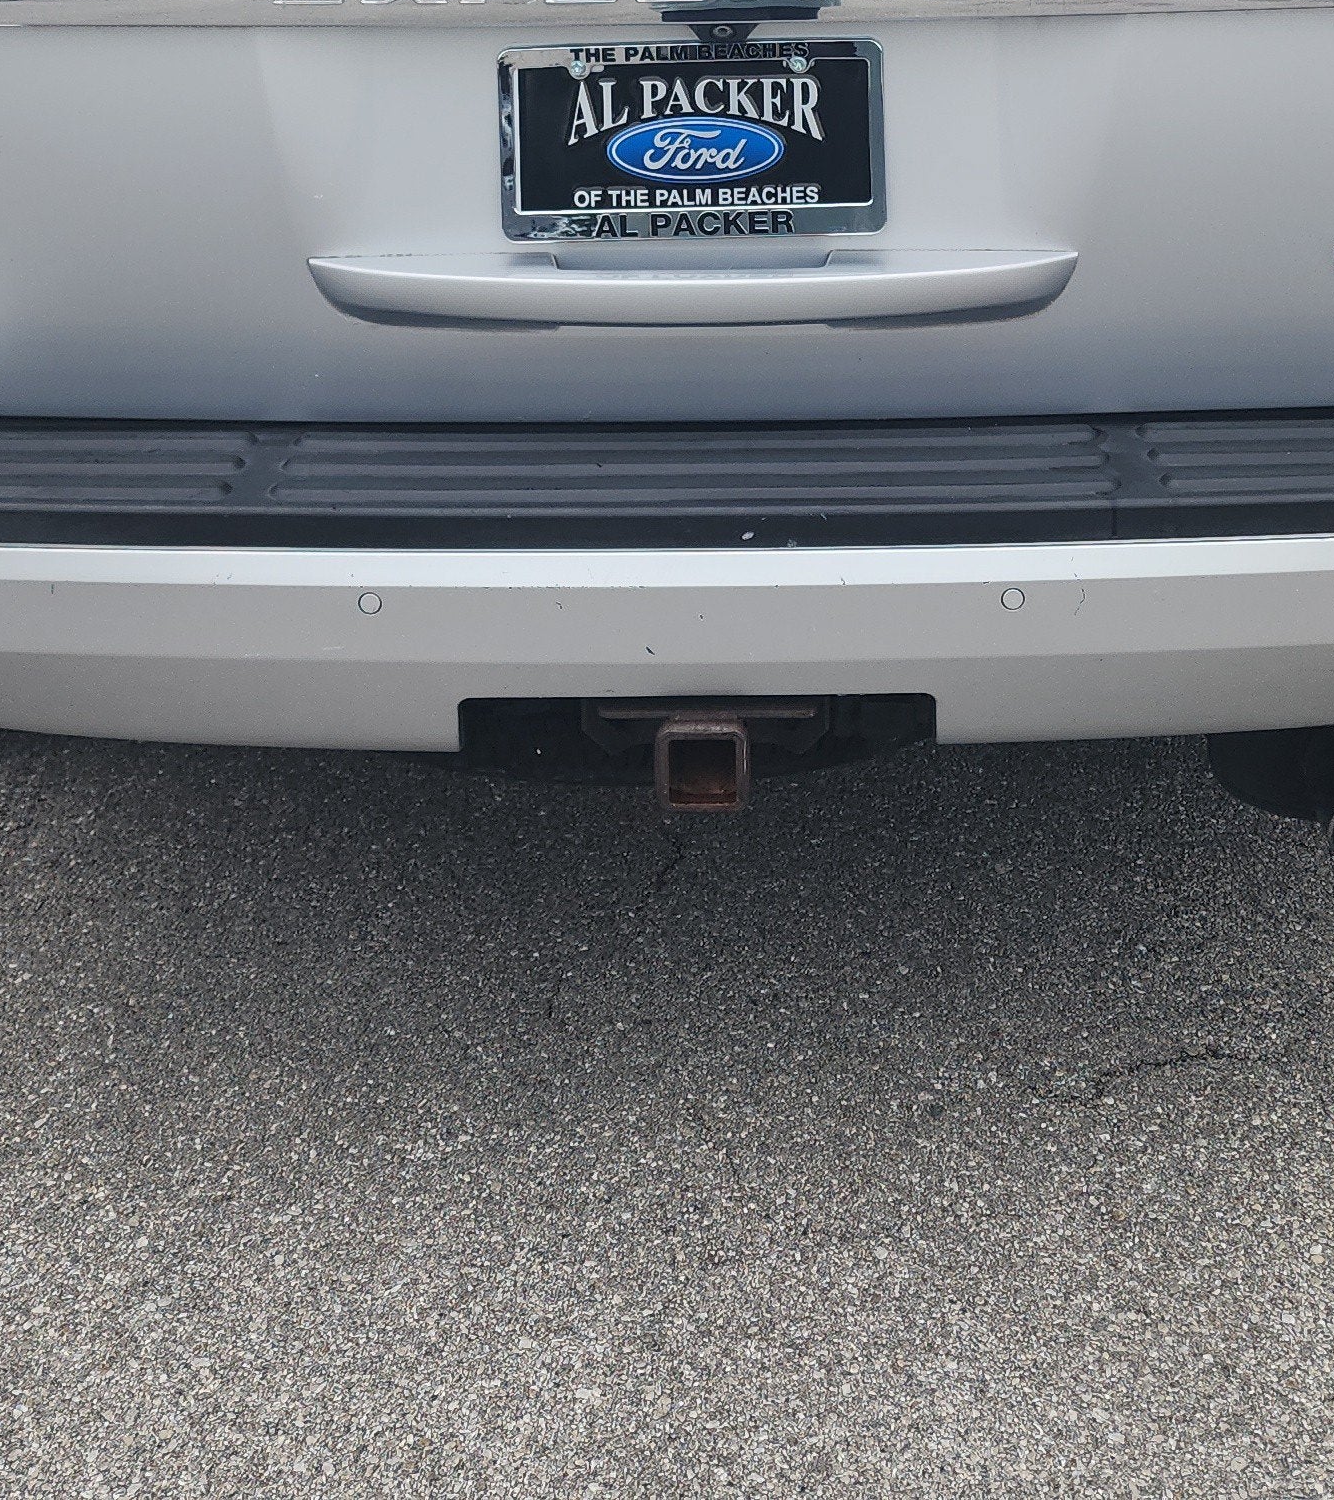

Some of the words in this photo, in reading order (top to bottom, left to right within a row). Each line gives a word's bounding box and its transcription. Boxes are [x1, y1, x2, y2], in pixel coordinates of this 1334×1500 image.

[570, 46, 617, 64] THE
[624, 44, 691, 62] PALM
[696, 41, 809, 60] BEACHES
[567, 79, 630, 146] AL
[639, 76, 824, 142] PACKER
[643, 127, 748, 172] Ford
[573, 190, 602, 208] OF
[607, 189, 651, 207] THE
[655, 188, 712, 206] PALM
[720, 186, 819, 205] BEACHES
[595, 213, 640, 238] AL
[650, 209, 795, 237] PACKER
